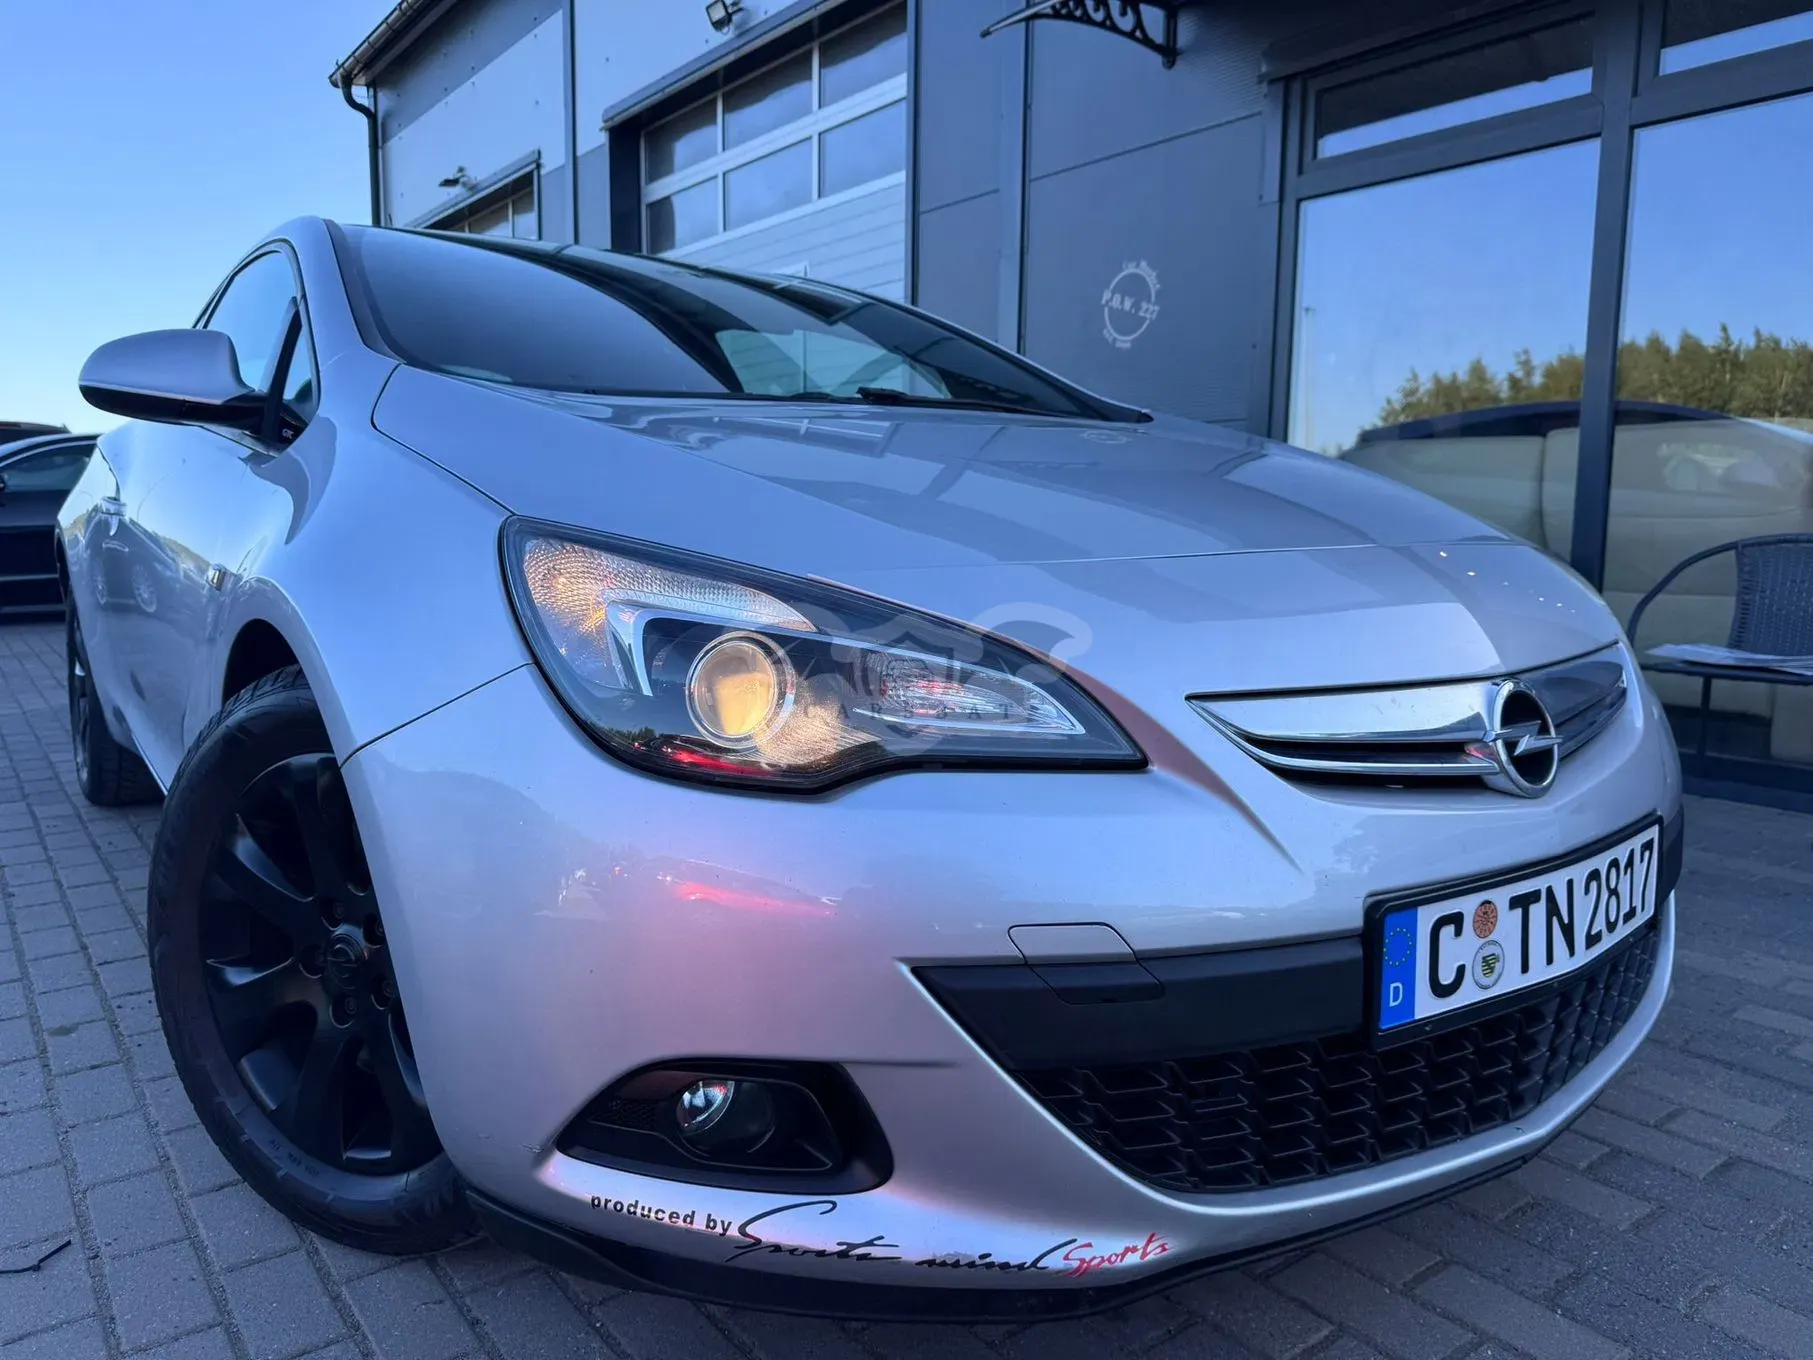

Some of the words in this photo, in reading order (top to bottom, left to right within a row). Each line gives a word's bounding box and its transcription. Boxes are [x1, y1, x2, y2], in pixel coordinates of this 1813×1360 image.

[1389, 982, 1403, 1007] D
[1428, 911, 1465, 999] C
[590, 1194, 696, 1227] produced
[705, 1213, 732, 1237] by
[1057, 1232, 1171, 1279] Sports
